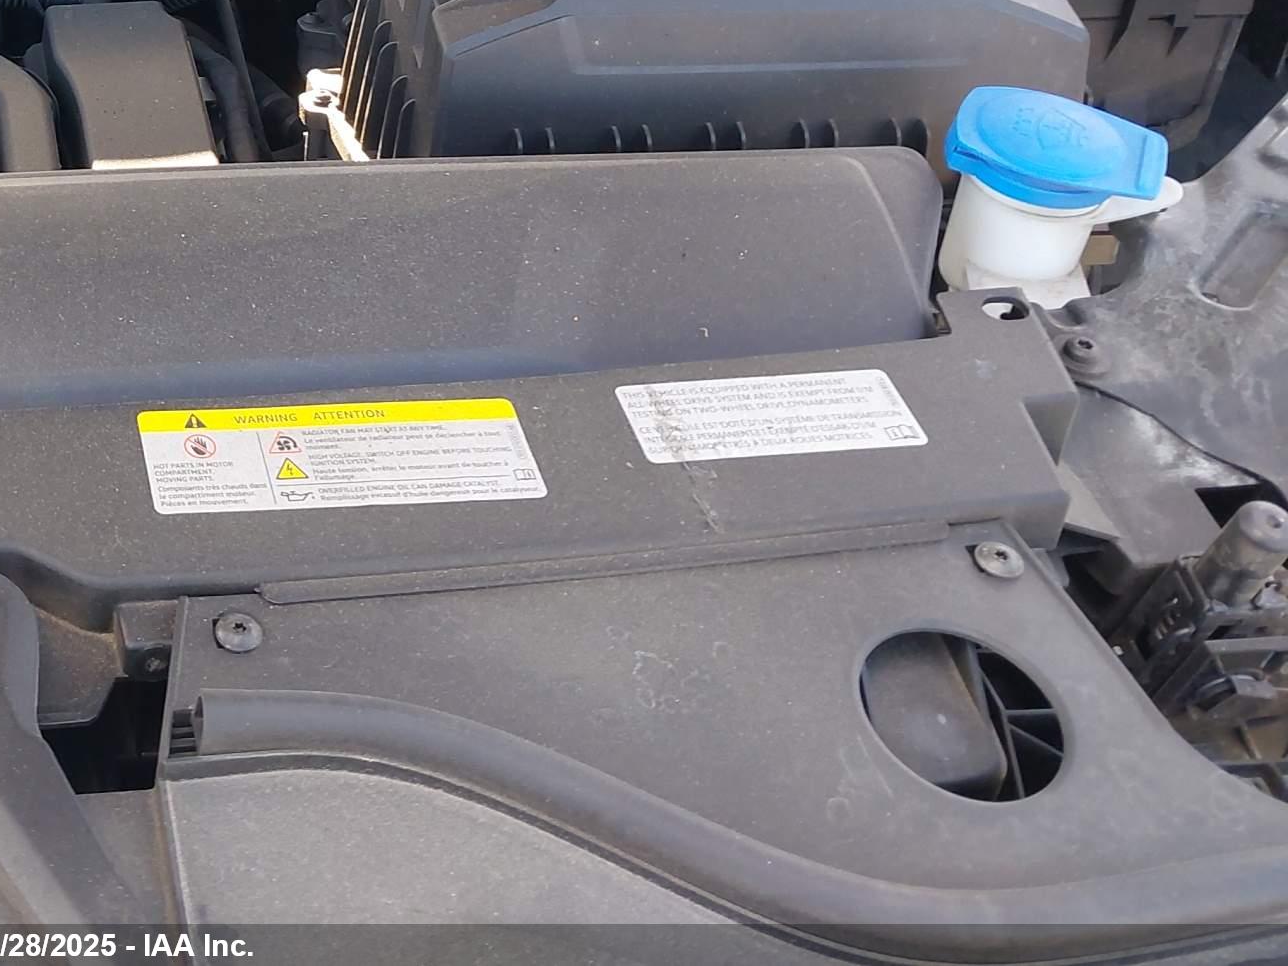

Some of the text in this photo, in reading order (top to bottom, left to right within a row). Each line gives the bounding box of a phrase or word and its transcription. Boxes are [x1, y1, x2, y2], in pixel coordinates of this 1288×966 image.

[233, 409, 385, 424] WARNING ATTENTION
[206, 460, 234, 468] MOTOR
[155, 475, 188, 483] MOVING
[367, 484, 395, 492] ENGINE
[429, 481, 461, 489] DAMAGE
